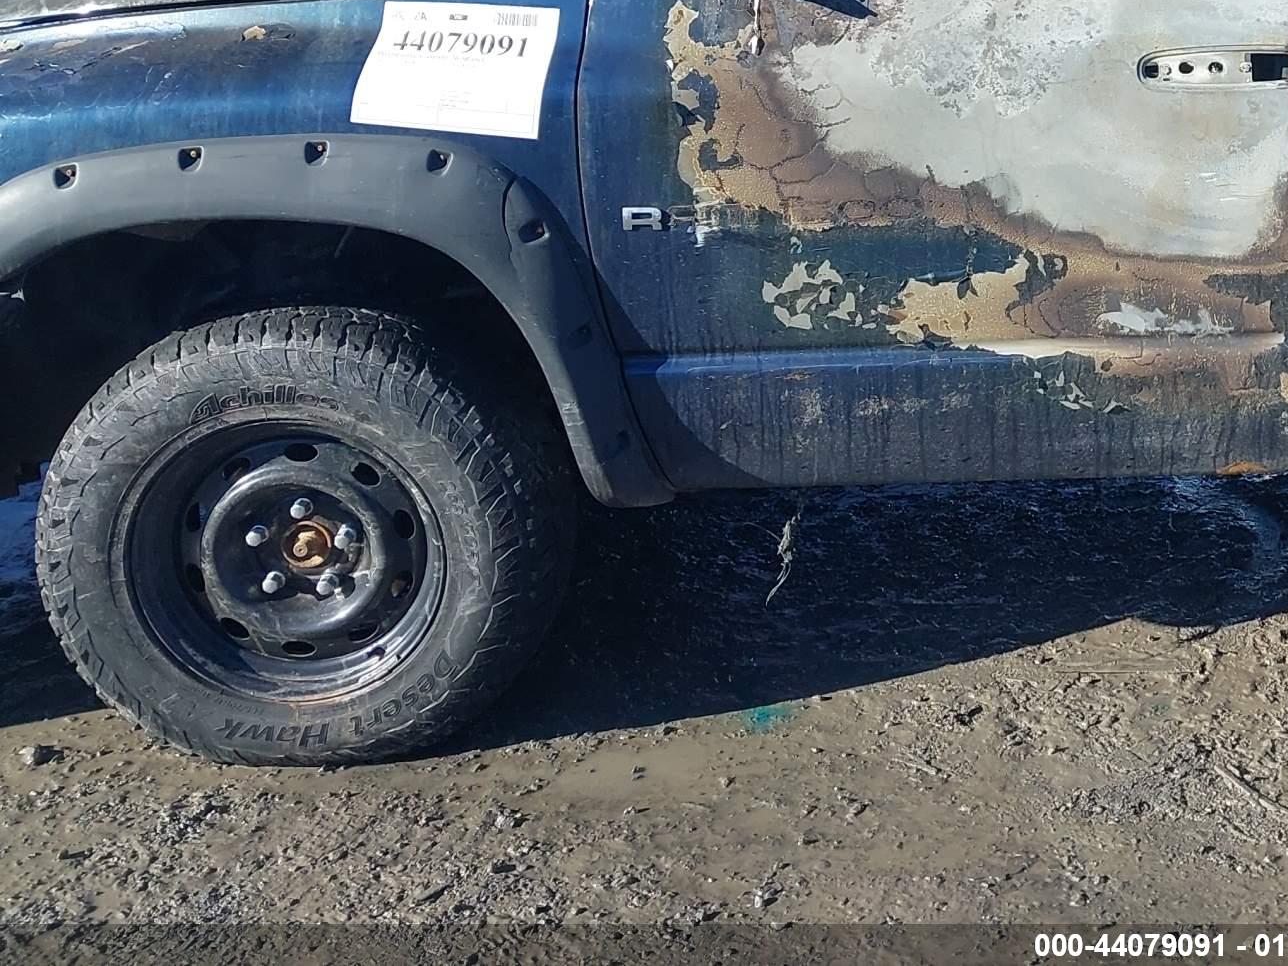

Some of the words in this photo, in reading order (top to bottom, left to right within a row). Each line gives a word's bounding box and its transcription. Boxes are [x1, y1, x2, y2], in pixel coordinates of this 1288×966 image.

[392, 30, 528, 58] 44079091
[189, 384, 341, 424] Achilles
[347, 650, 460, 737] Desert
[214, 715, 331, 749] Hawk
